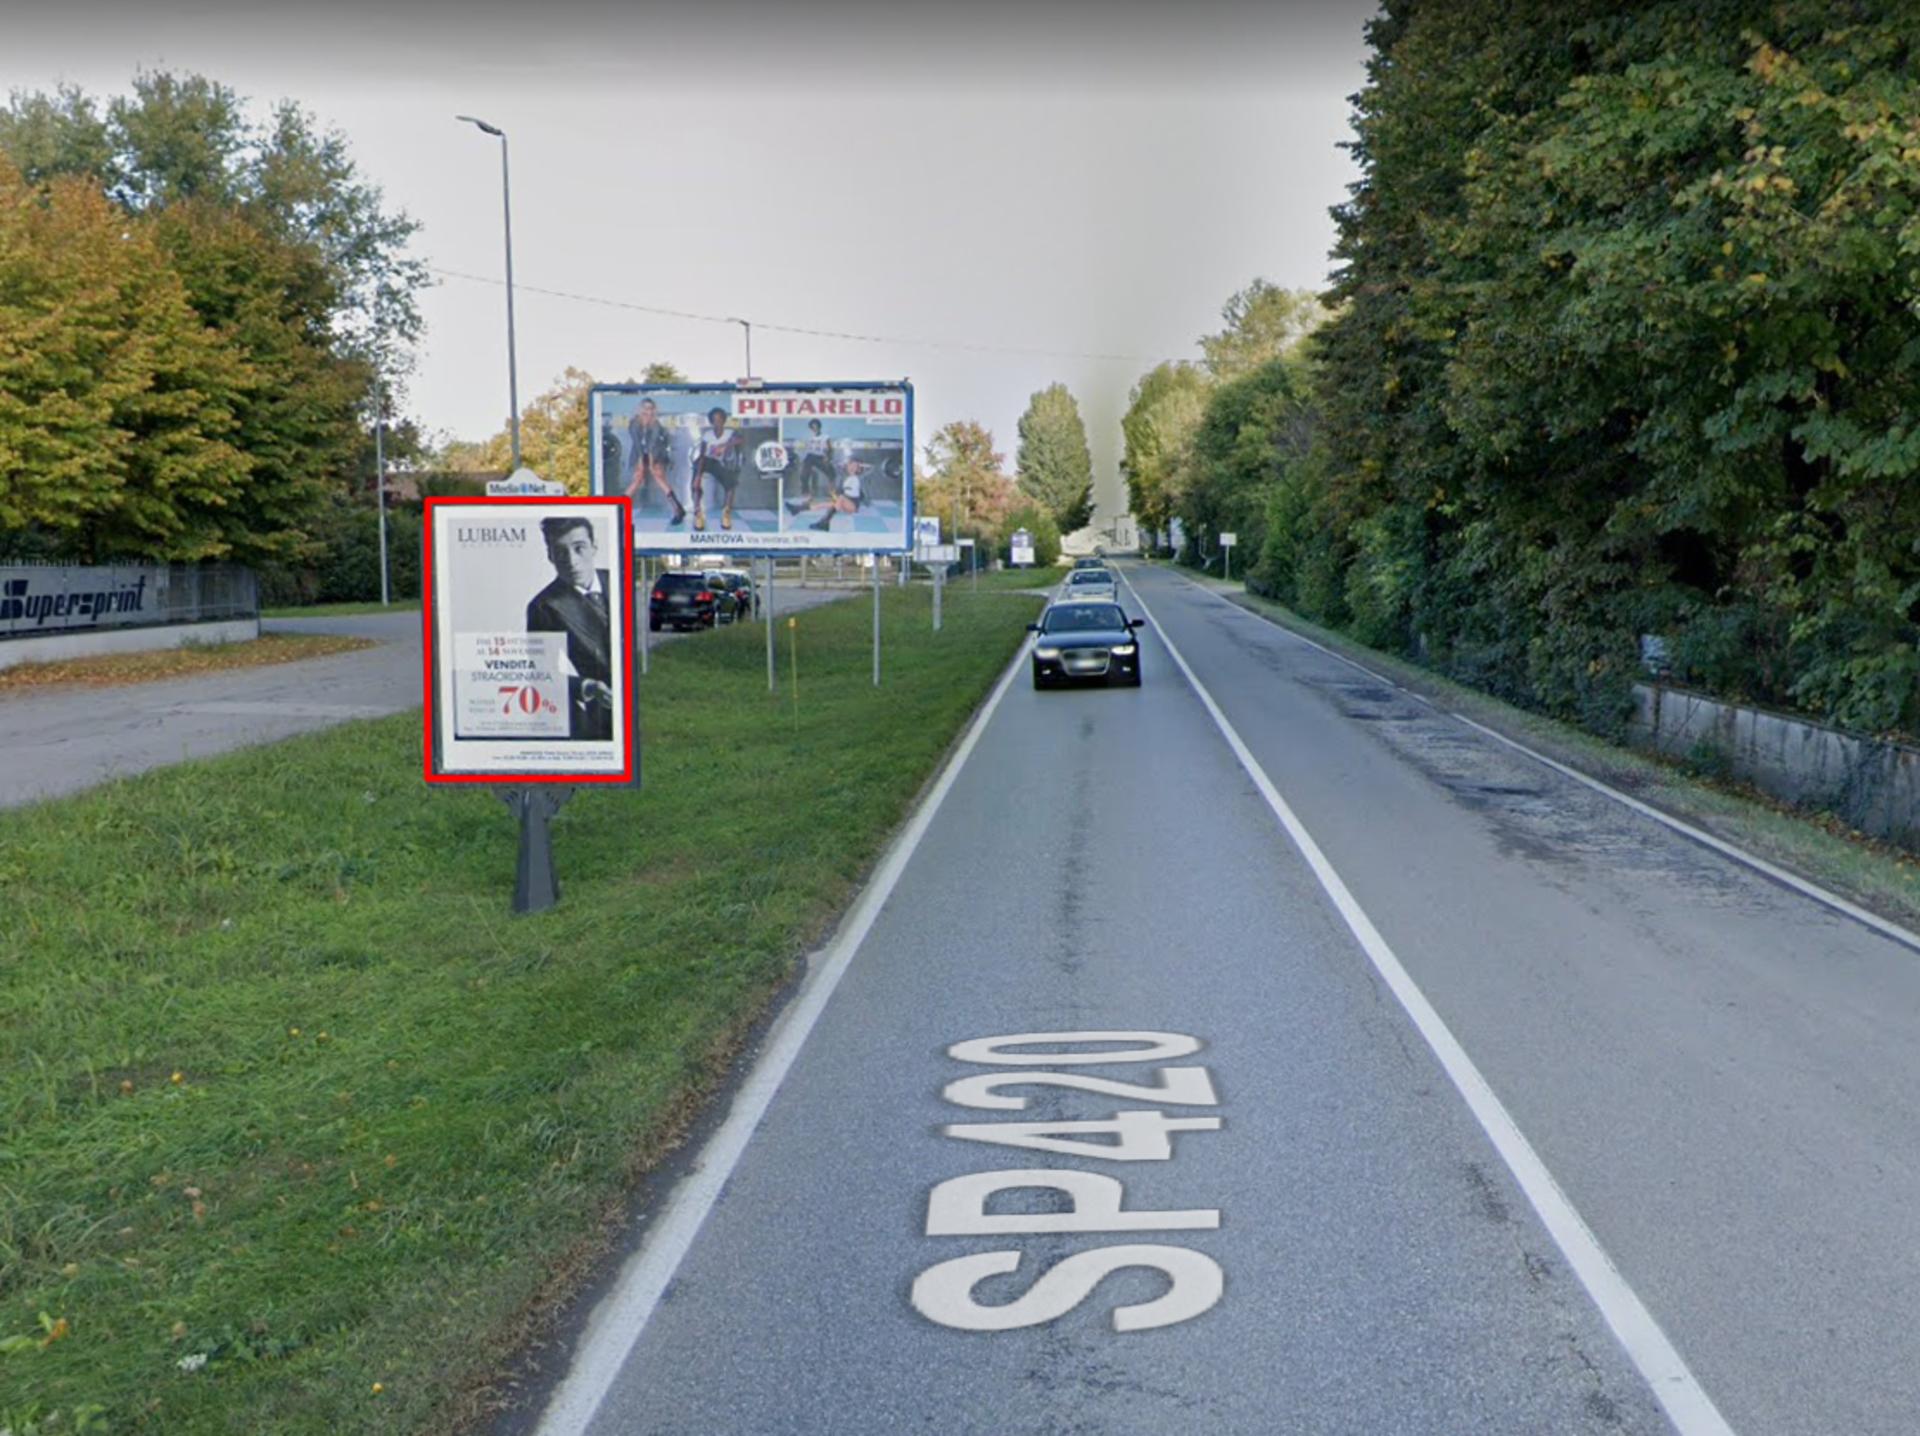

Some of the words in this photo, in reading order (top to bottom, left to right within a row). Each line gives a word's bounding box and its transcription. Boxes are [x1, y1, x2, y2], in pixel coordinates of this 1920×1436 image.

[738, 398, 904, 415] PITTARELLO
[457, 527, 527, 542] LUBIAM
[690, 533, 744, 544] MANTOVA
[485, 660, 536, 669] VENDITA
[471, 671, 553, 682] STRAORDINARIA
[498, 686, 558, 715] 70%
[911, 1031, 1224, 1332] SP420
